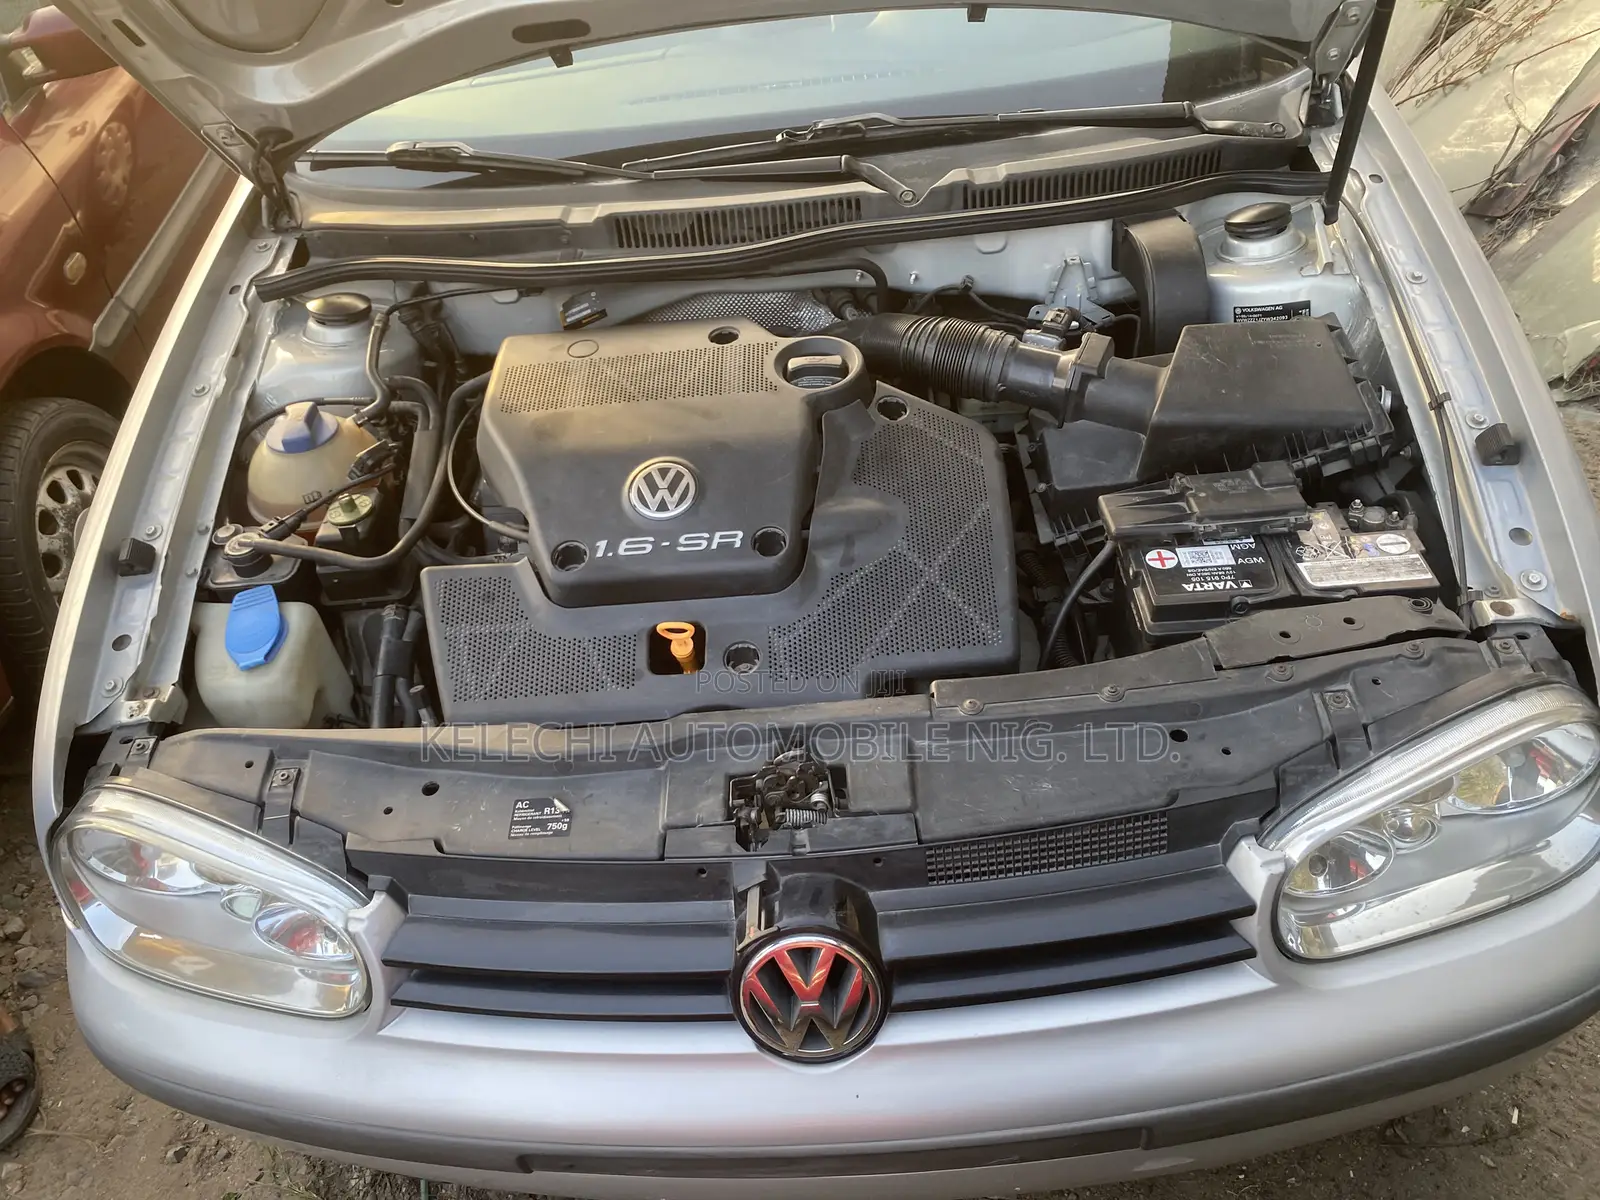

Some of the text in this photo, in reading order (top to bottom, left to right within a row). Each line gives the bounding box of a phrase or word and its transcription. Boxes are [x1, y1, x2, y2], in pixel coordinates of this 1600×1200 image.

[1230, 542, 1256, 550] AGM
[1238, 556, 1265, 565] AGM
[1181, 580, 1238, 592] VARTA
[515, 801, 529, 809] AC
[547, 822, 568, 831] 750g
